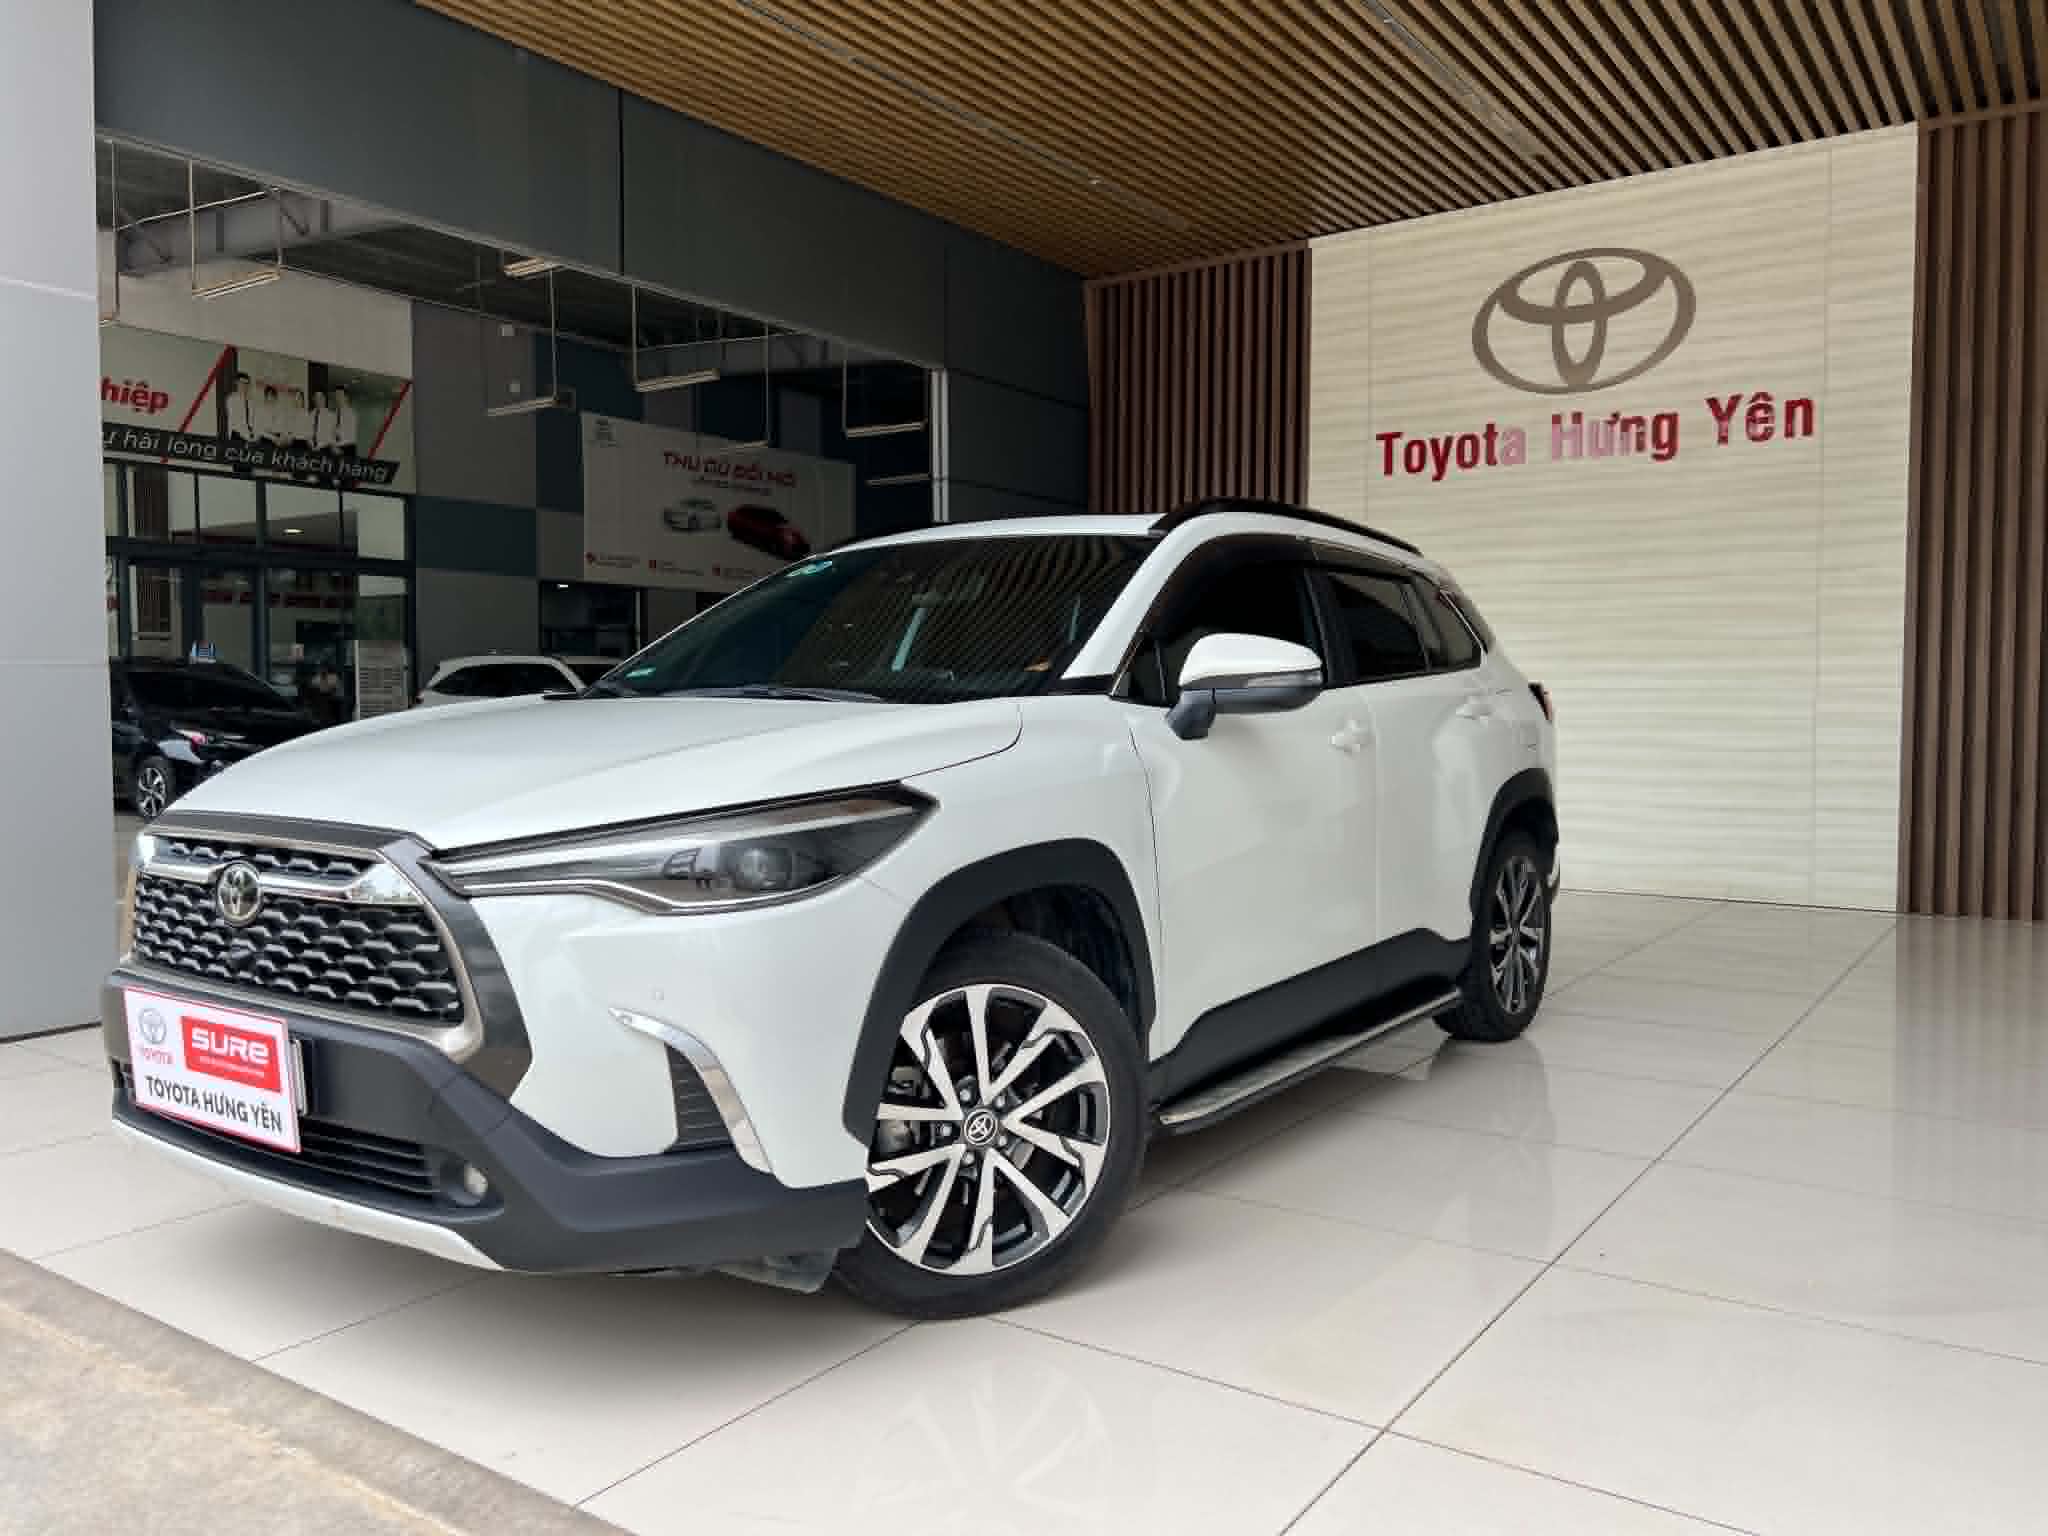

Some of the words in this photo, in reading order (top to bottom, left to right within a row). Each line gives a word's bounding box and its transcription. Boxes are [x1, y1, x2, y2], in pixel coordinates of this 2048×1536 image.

[1376, 423, 1527, 482] Toyota
[1551, 411, 1680, 462] Hưng
[1705, 391, 1815, 446] Yên
[145, 1075, 201, 1109] TOYOTA
